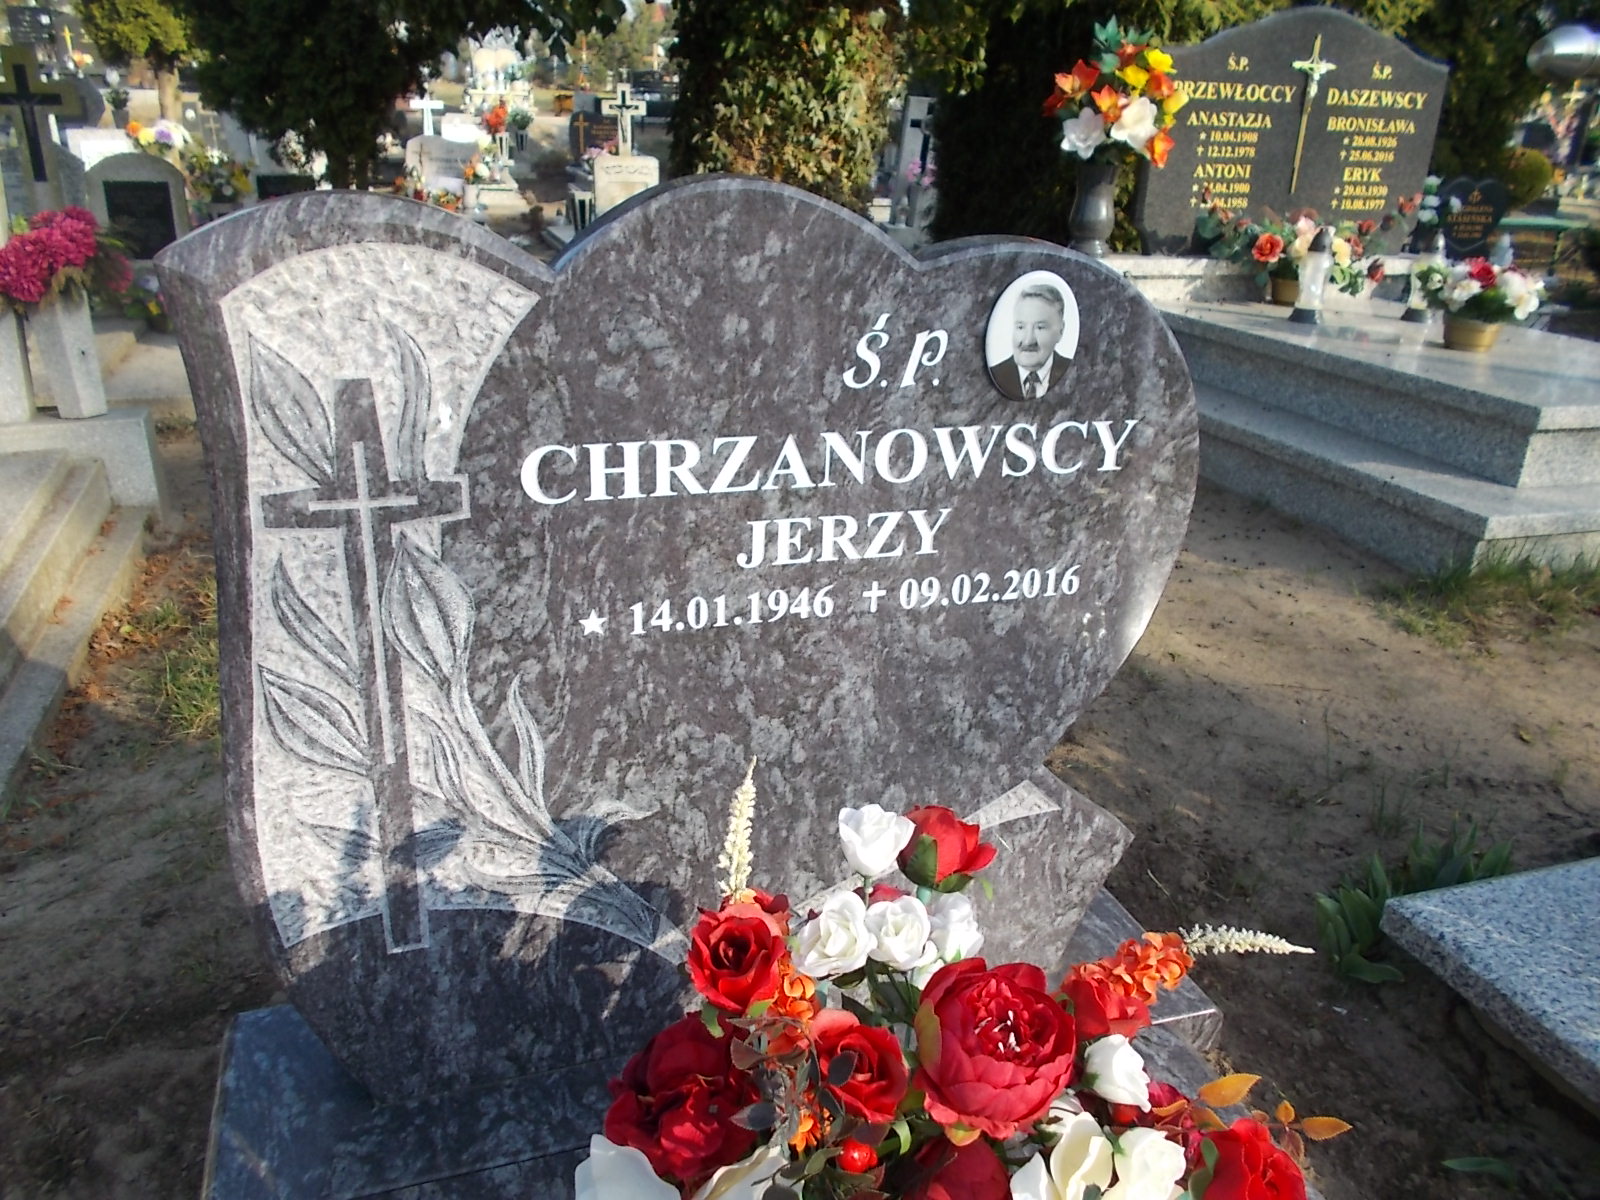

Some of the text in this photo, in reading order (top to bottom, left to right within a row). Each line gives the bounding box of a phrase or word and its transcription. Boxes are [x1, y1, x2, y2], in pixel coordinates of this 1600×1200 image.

[1327, 87, 1428, 110] DASZEWSCY
[1187, 111, 1272, 129] ANASTAZJA
[1327, 116, 1416, 135] BRONISŁAWA
[1207, 145, 1256, 158] 12.12.1978
[1193, 163, 1252, 179] ANTONI
[1343, 167, 1383, 182] ERYK
[520, 419, 1139, 505] CHRZANOWSCY
[737, 508, 952, 569] JERZY
[629, 564, 1081, 636] 14.01.1946 09.02.2016
